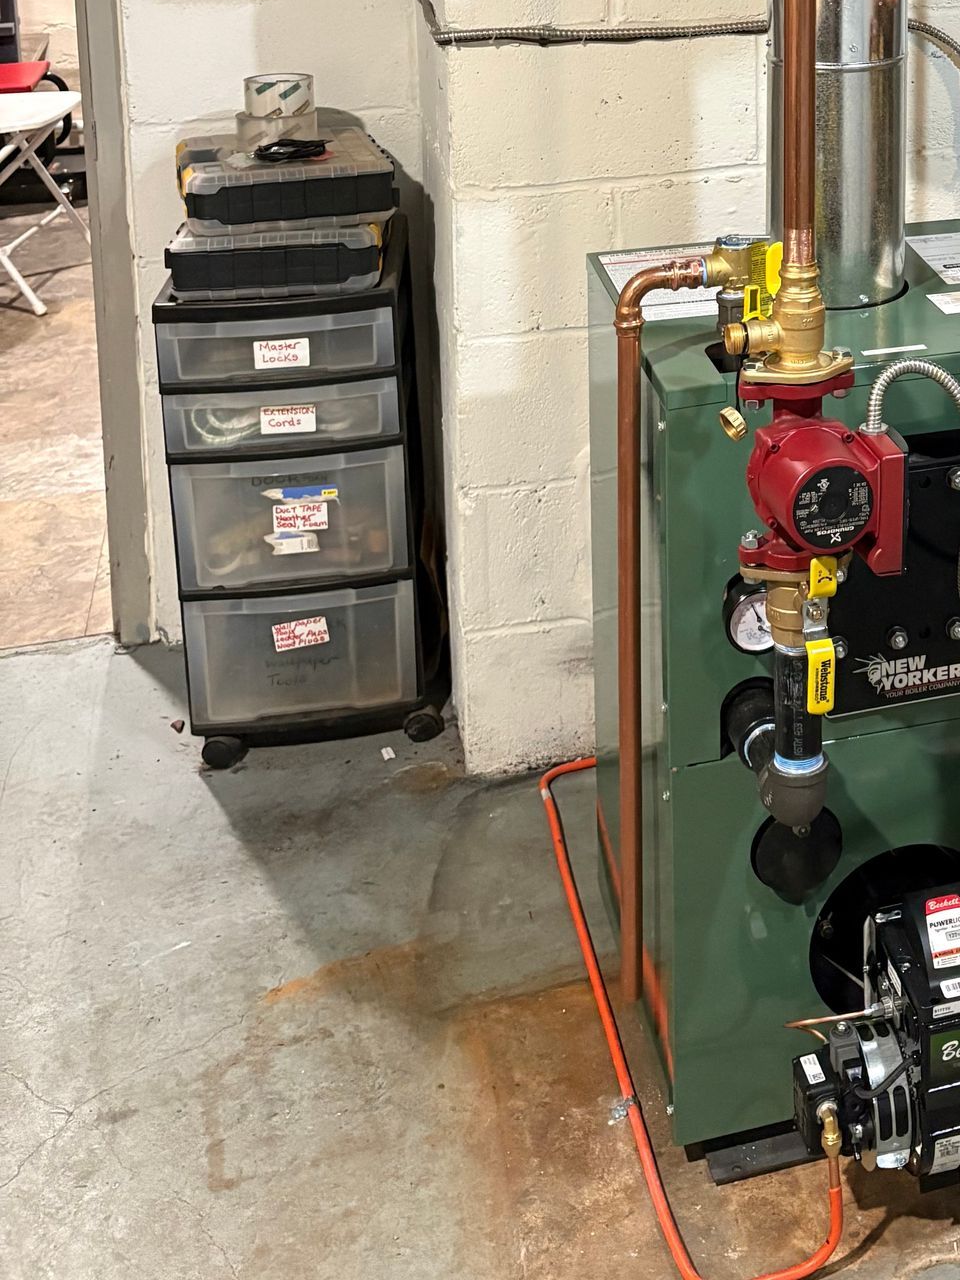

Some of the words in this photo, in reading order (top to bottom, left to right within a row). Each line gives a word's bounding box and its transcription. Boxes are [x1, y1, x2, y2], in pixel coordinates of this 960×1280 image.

[260, 342, 301, 352] Master
[263, 406, 315, 416] EXTENSION
[268, 418, 302, 427] Cords
[299, 504, 323, 513] TAPE
[816, 525, 855, 536] GRUNDFOS
[881, 655, 927, 676] NEW
[820, 658, 830, 702] Webstone
[885, 690, 904, 699] YOUR
[905, 686, 928, 696] BOILER
[928, 680, 960, 691] COMPANY
[928, 898, 960, 910] Beckett
